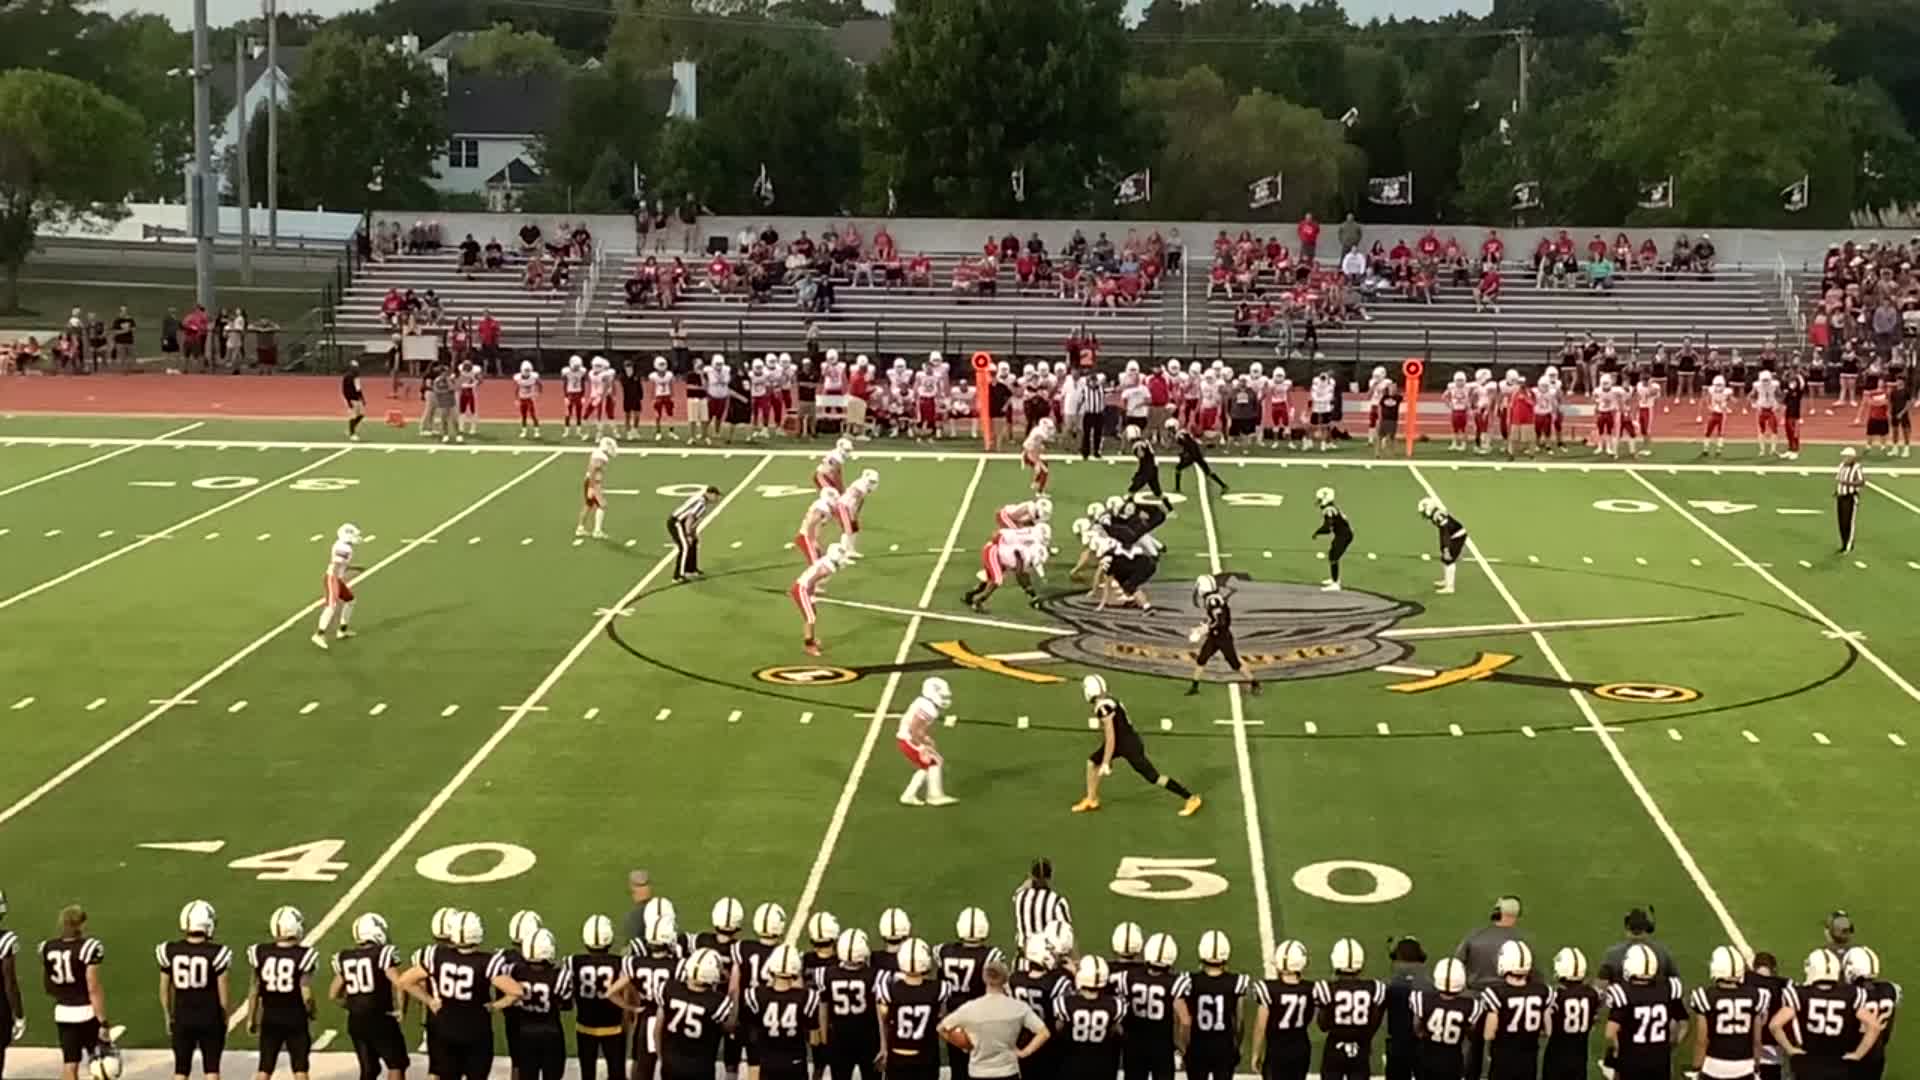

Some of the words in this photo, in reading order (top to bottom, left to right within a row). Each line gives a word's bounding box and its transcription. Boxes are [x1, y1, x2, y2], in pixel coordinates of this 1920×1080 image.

[47, 950, 75, 984] 31
[172, 955, 208, 989] 60
[261, 957, 294, 993] 48
[343, 958, 374, 994] 50
[439, 963, 474, 1000] 62
[944, 958, 975, 992] 57
[831, 980, 866, 1015] 53
[1131, 983, 1165, 1020] 26
[1197, 994, 1225, 1031] 61
[1278, 994, 1307, 1029] 71
[1334, 990, 1371, 1025] 28
[1507, 995, 1542, 1032] 76
[1564, 997, 1590, 1034] 81
[667, 999, 705, 1038] 75
[763, 1001, 798, 1037] 44
[897, 1005, 931, 1040] 67
[1072, 1009, 1109, 1042] 88
[1427, 1007, 1464, 1045] 46
[1633, 1004, 1668, 1043] 72
[1716, 998, 1752, 1034] 25
[1806, 998, 1846, 1036] 55
